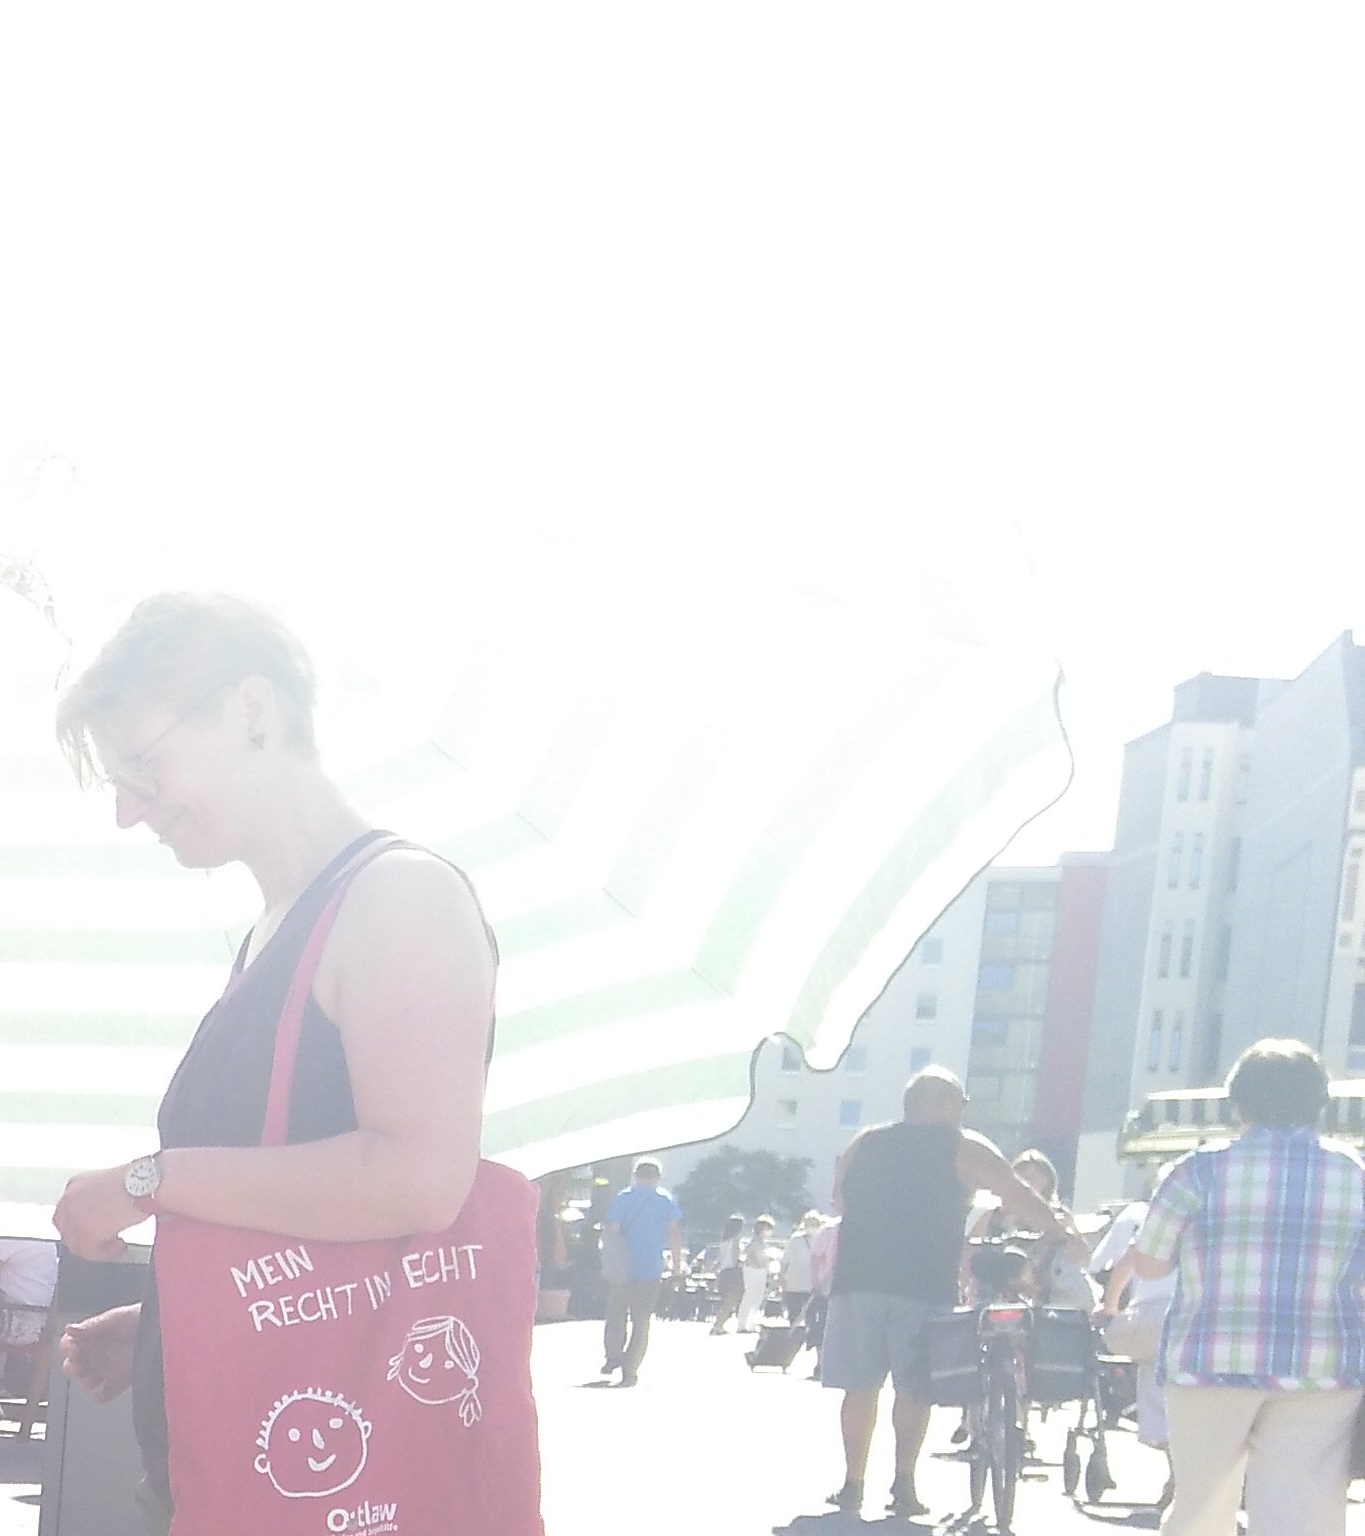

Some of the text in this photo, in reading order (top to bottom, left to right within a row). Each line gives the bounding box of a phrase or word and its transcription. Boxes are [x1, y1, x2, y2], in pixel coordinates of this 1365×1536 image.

[229, 1245, 315, 1298] MEIN
[248, 1244, 484, 1332] RECHT IN ECHT
[327, 1500, 398, 1532] Otlaw
